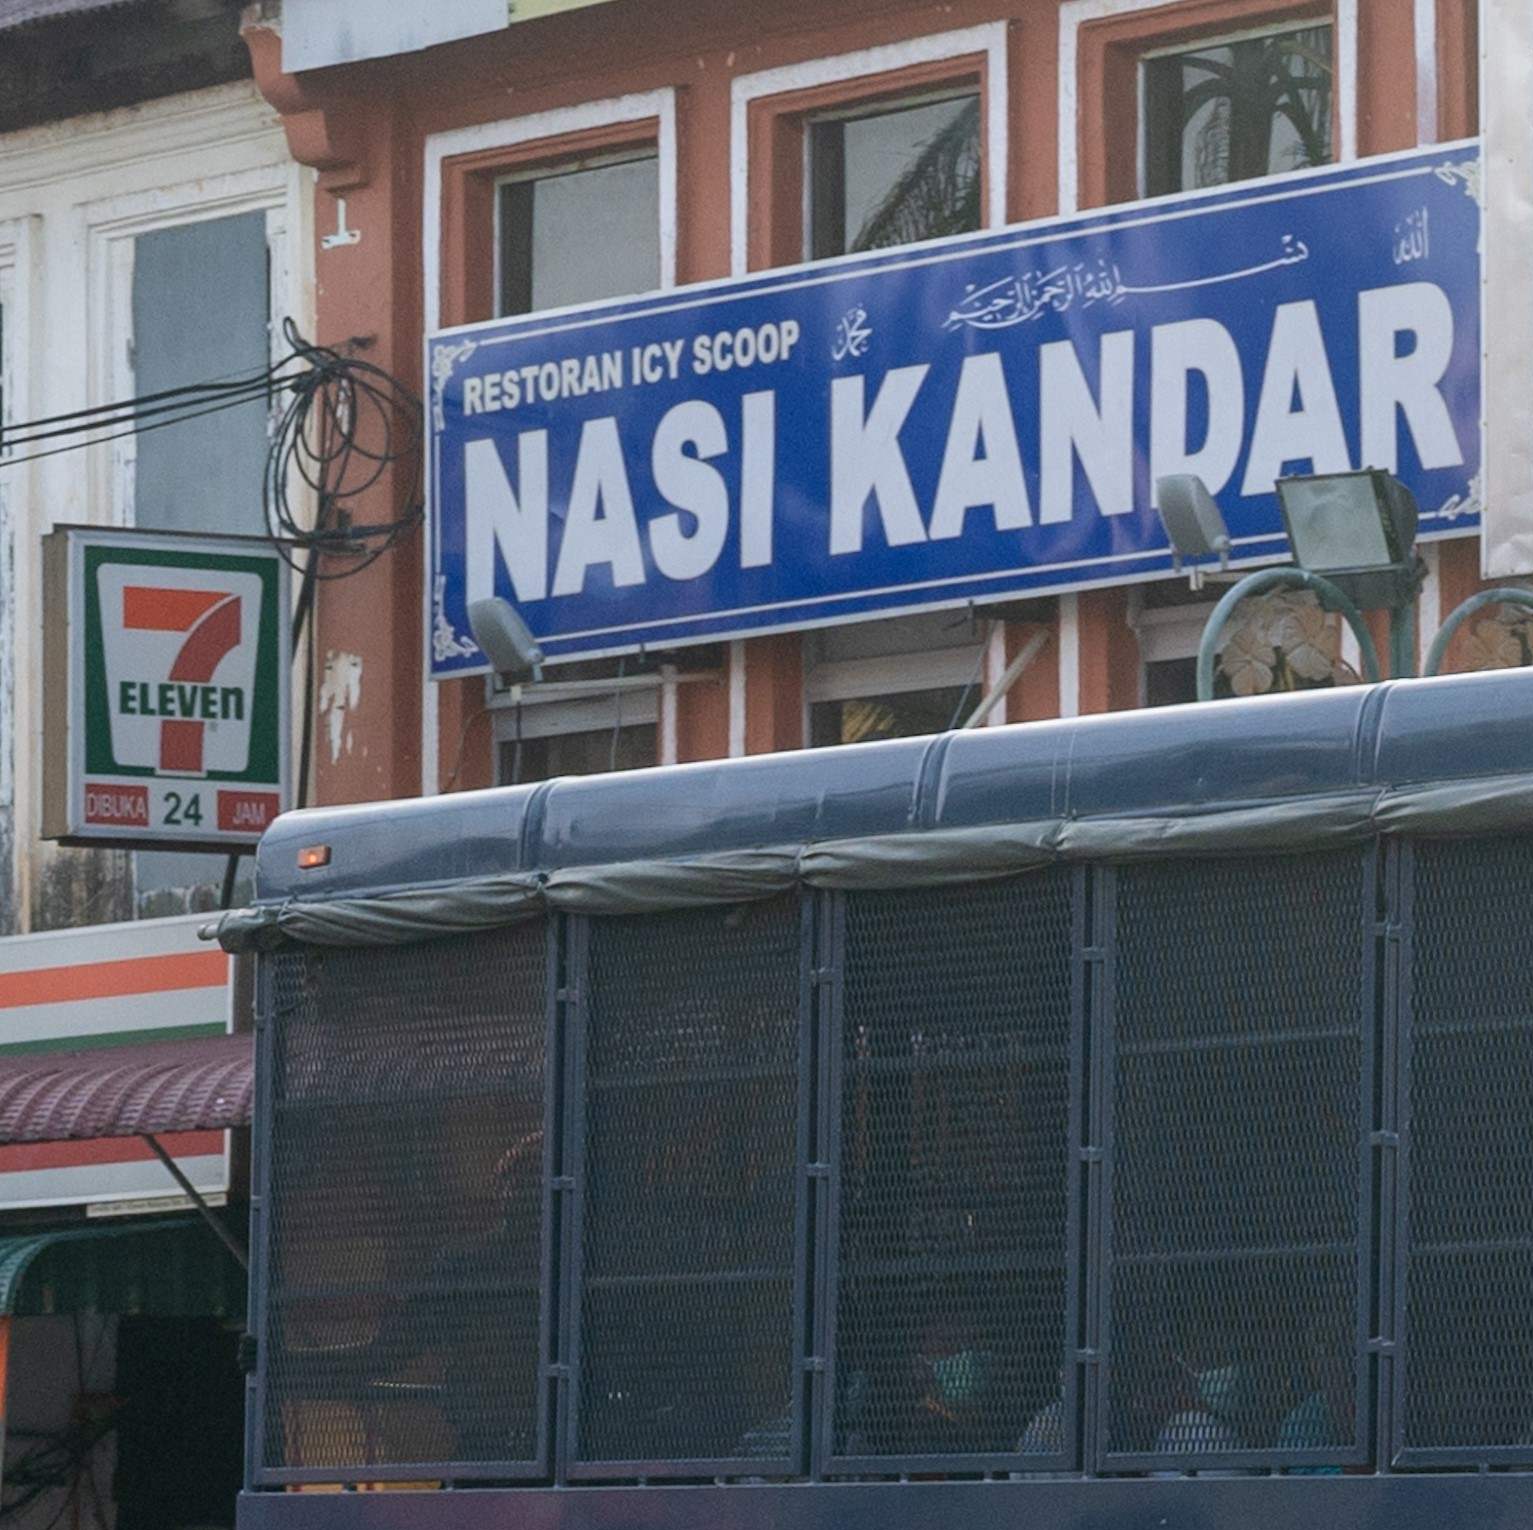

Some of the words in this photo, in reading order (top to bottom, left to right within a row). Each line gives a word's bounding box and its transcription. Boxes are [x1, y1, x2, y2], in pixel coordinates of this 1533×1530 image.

[463, 348, 623, 416] RESTORAN
[632, 337, 685, 386] ICY
[693, 320, 800, 376] SCOOP
[464, 389, 776, 602] NASI
[828, 280, 1465, 556] KANDAR
[122, 586, 242, 684] 7
[87, 793, 147, 820] DIBUKA
[163, 791, 203, 827] 24
[231, 801, 266, 826] JAM
